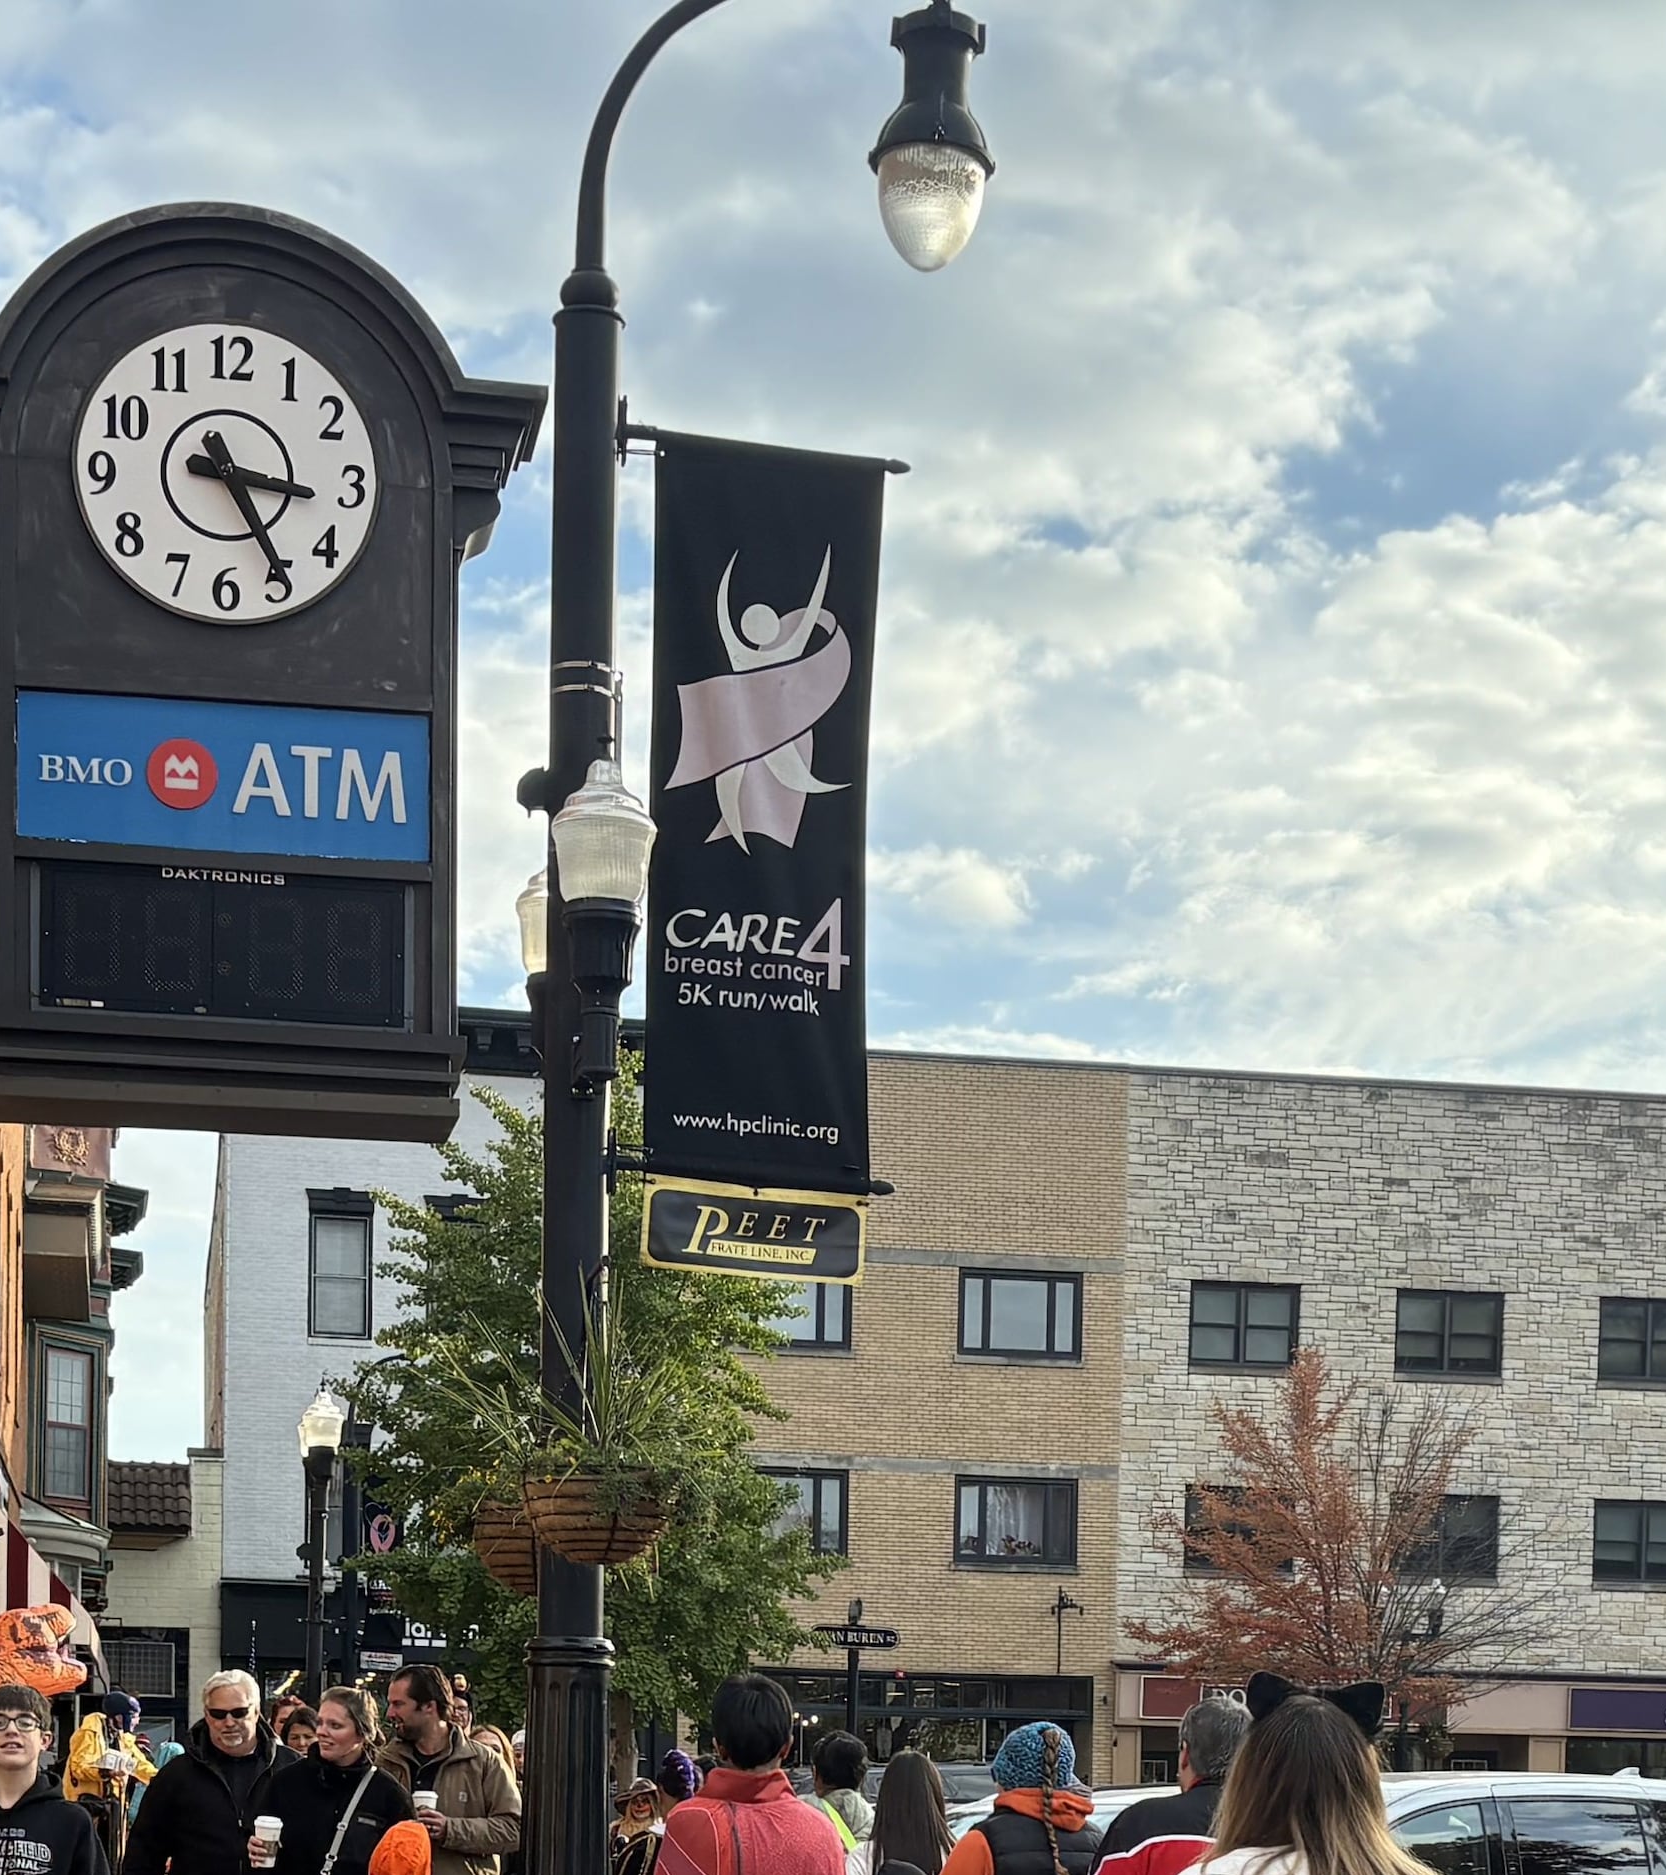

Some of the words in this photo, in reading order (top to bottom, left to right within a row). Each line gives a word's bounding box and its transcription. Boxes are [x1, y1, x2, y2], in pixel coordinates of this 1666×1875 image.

[151, 346, 189, 393] 11
[209, 335, 254, 381] 12
[281, 357, 299, 402] 1
[102, 393, 149, 441] 10
[318, 395, 345, 441] 2
[87, 450, 117, 495] 9
[337, 464, 366, 509] 3
[115, 511, 144, 558] 8
[312, 524, 340, 569] 4
[165, 552, 191, 598] 7
[212, 567, 241, 611] 6
[265, 558, 293, 603] 5
[38, 753, 133, 788] BMO
[232, 741, 408, 824] ATM
[161, 867, 286, 885] DAKTRONICS
[664, 948, 743, 977] breast
[749, 962, 825, 987] cancer
[677, 982, 712, 1006] 5K
[718, 988, 820, 1017] run/walk
[673, 1111, 839, 1145] www.hpclinic.org
[681, 1204, 826, 1255] PEET
[711, 1242, 748, 1256] FRATE
[785, 1249, 811, 1261] INC.
[847, 1631, 884, 1644] BUREN
